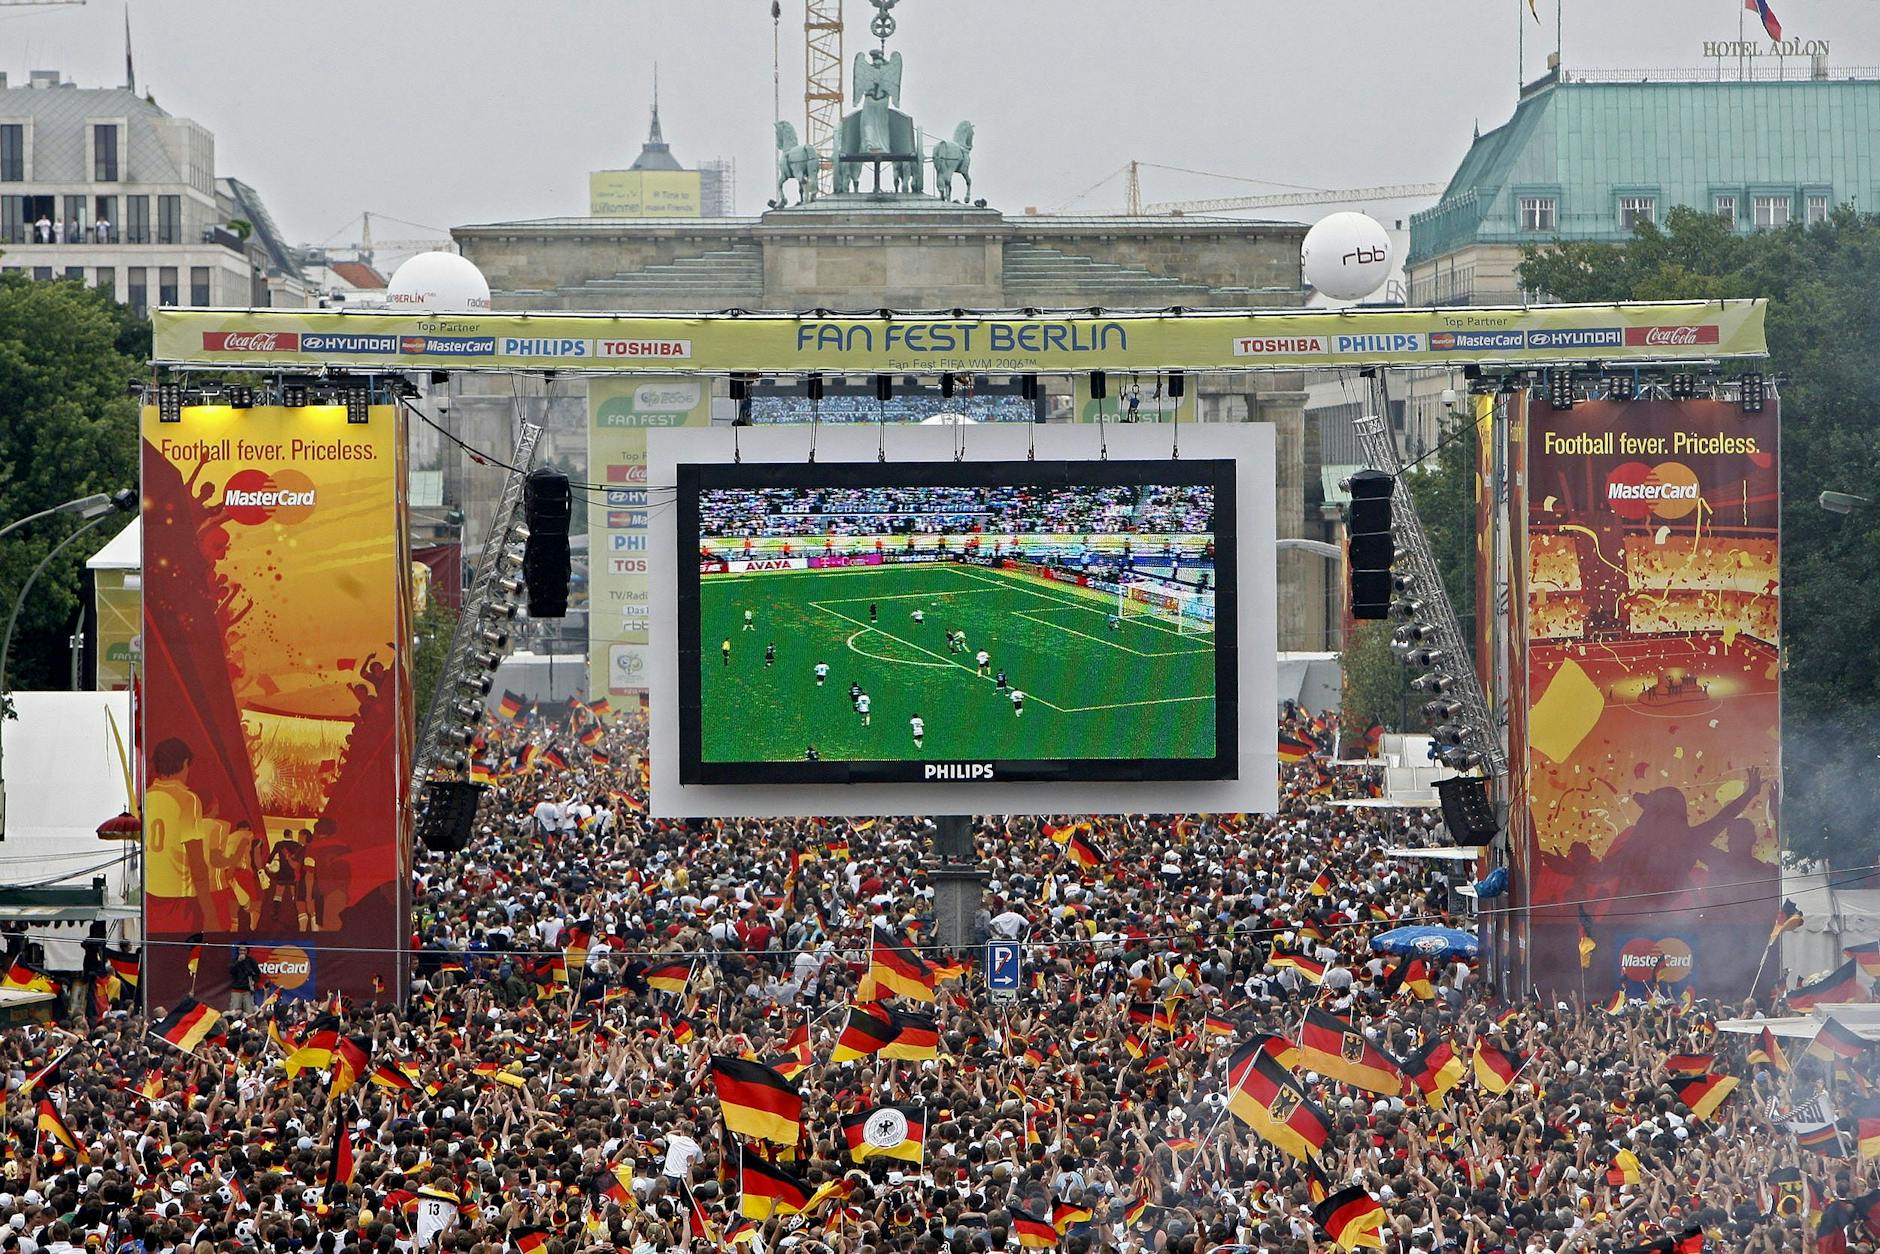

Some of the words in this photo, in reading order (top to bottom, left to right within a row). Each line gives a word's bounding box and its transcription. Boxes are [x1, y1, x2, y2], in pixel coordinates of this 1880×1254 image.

[1703, 41, 1762, 57] HOTEL
[1769, 40, 1830, 56] ADLON
[1342, 245, 1386, 266] rbb
[417, 321, 436, 333] Top
[440, 321, 480, 333] Partner
[1443, 316, 1463, 328] Top
[1467, 316, 1508, 326] Partner
[223, 332, 279, 351] Coca-Cola
[797, 323, 872, 352] FAN
[884, 323, 980, 352] FEST
[990, 323, 1128, 352] BERLIN
[1456, 333, 1523, 347] MasterCard
[1551, 331, 1621, 345] HYUNDAI
[1645, 326, 1700, 345] Coca-Cola
[325, 338, 396, 351] HYUNDAI
[427, 340, 494, 352] MasterCard
[505, 338, 586, 356] PHILIPS
[603, 342, 684, 356] TOSHIBA
[1240, 339, 1321, 353] TOSHIBA
[1338, 335, 1419, 352] PHILIPS
[888, 358, 909, 370] Fan
[913, 358, 938, 370] Fest
[940, 358, 966, 370] FIFA
[968, 358, 994, 370] WM
[607, 414, 636, 426] FAN
[640, 414, 677, 426] FEST
[160, 439, 230, 461] Football
[236, 438, 286, 461] fever.
[291, 438, 378, 460] Priceless.
[1544, 431, 1614, 455] Football
[1619, 431, 1669, 455] fever.
[1673, 431, 1761, 455] Priceless.
[621, 451, 640, 462] Top
[1608, 482, 1698, 499] MasterCard
[225, 489, 316, 507] MasterCard
[614, 535, 646, 550] PHI
[614, 559, 647, 572] TOS
[745, 559, 792, 572] AVAYA
[924, 763, 994, 779] PHILIPS
[994, 946, 1013, 974] P
[257, 961, 309, 974] sterCard
[428, 1202, 440, 1216] 13
